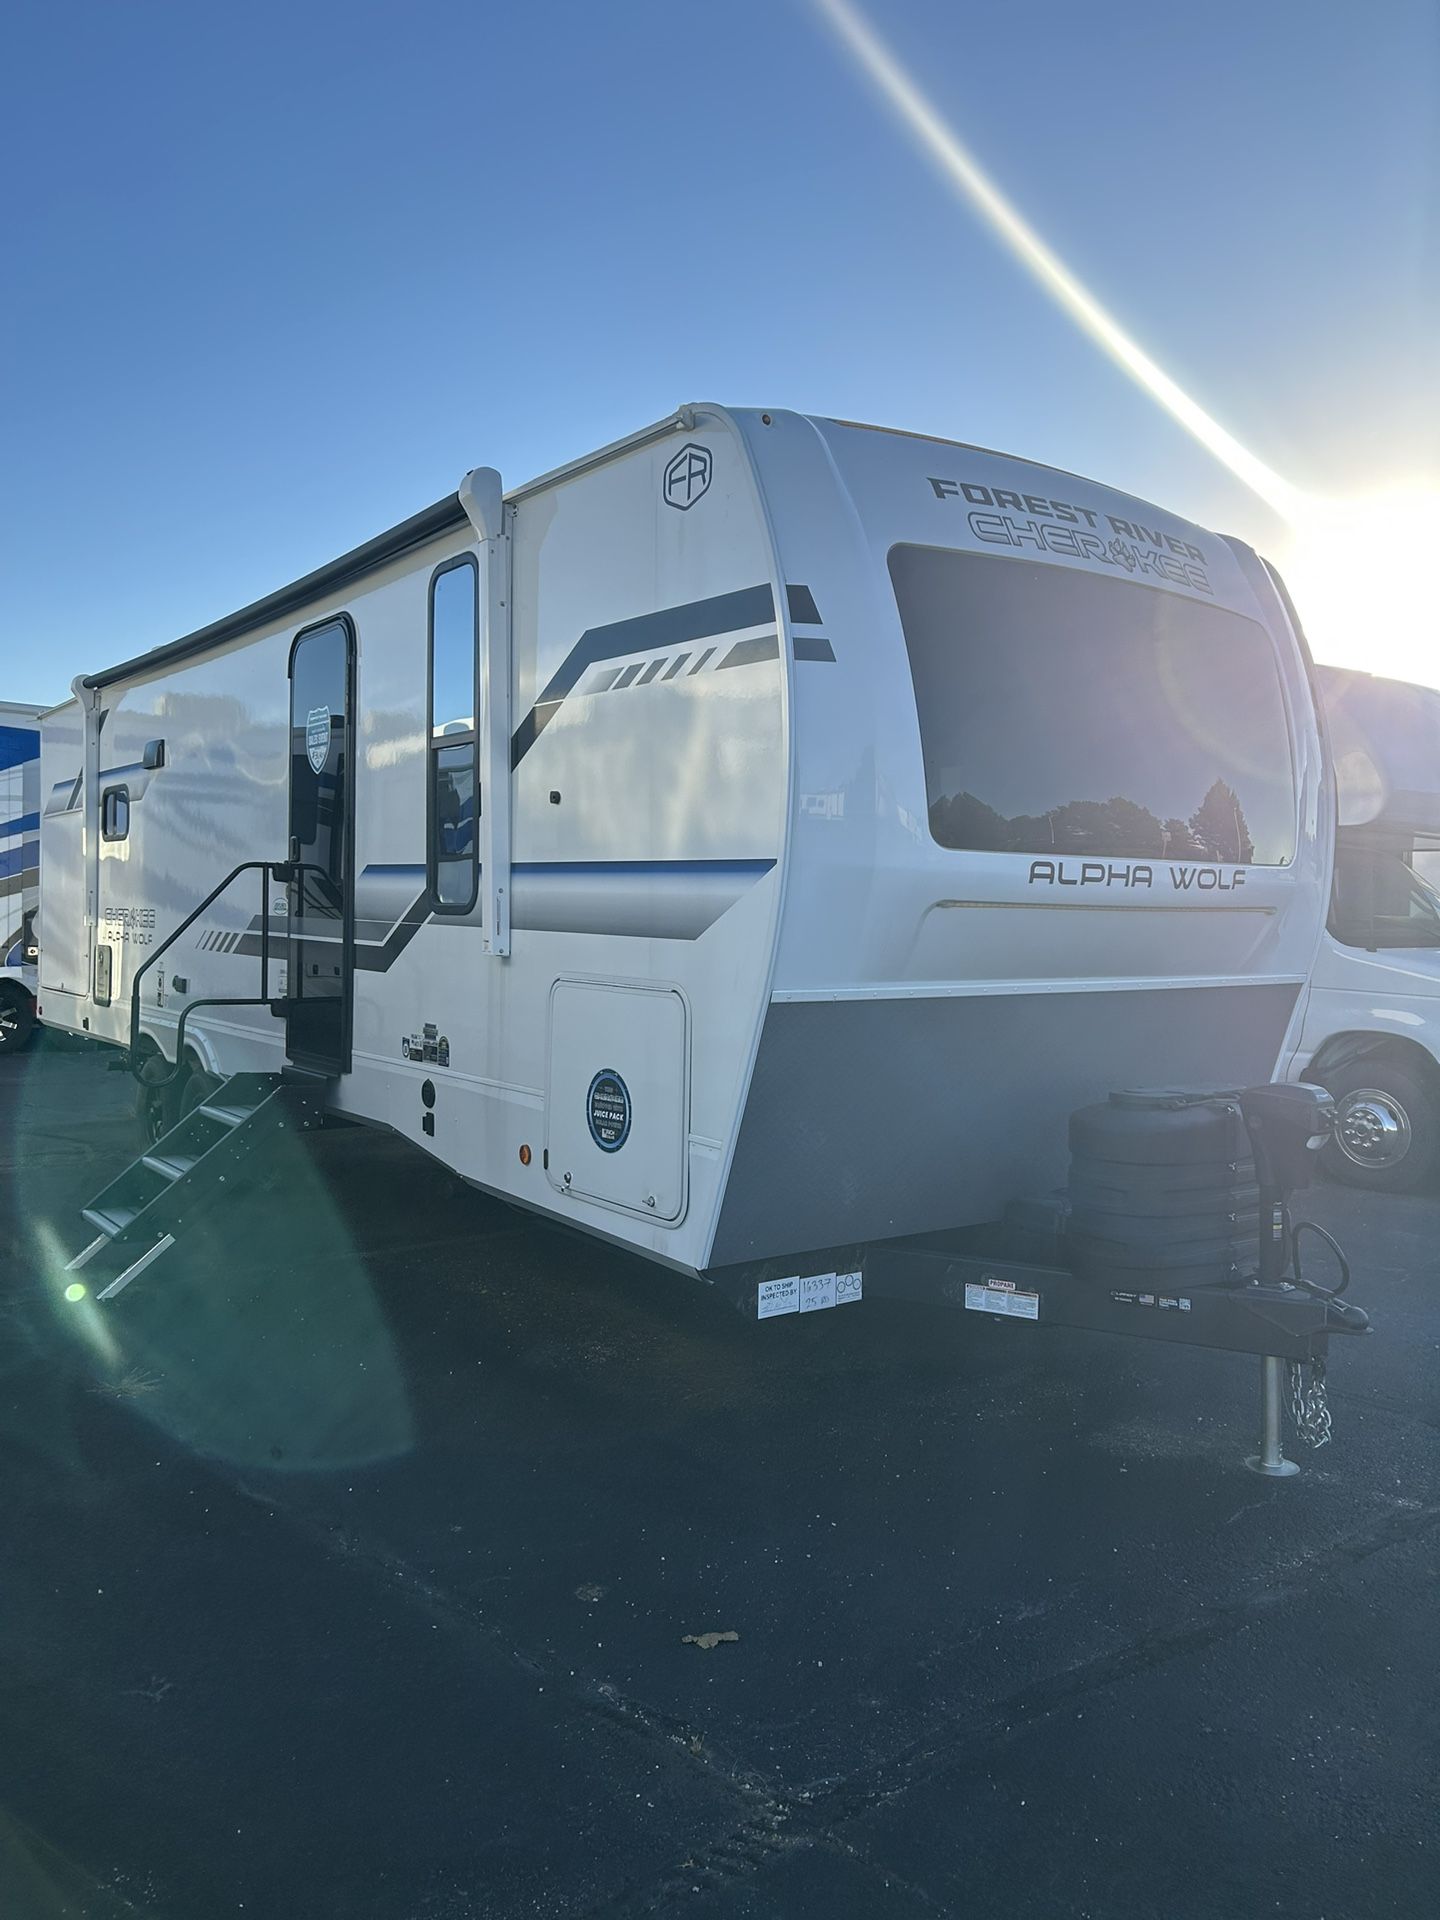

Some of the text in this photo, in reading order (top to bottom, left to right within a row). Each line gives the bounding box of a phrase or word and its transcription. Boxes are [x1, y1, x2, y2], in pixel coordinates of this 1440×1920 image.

[926, 477, 1208, 566] FOREST RIVER
[1028, 860, 1247, 890] ALPHA WOLF
[593, 1110, 624, 1121] JUICE PACK
[782, 1281, 794, 1289] SHIP
[761, 1290, 789, 1300] INSPECTED
